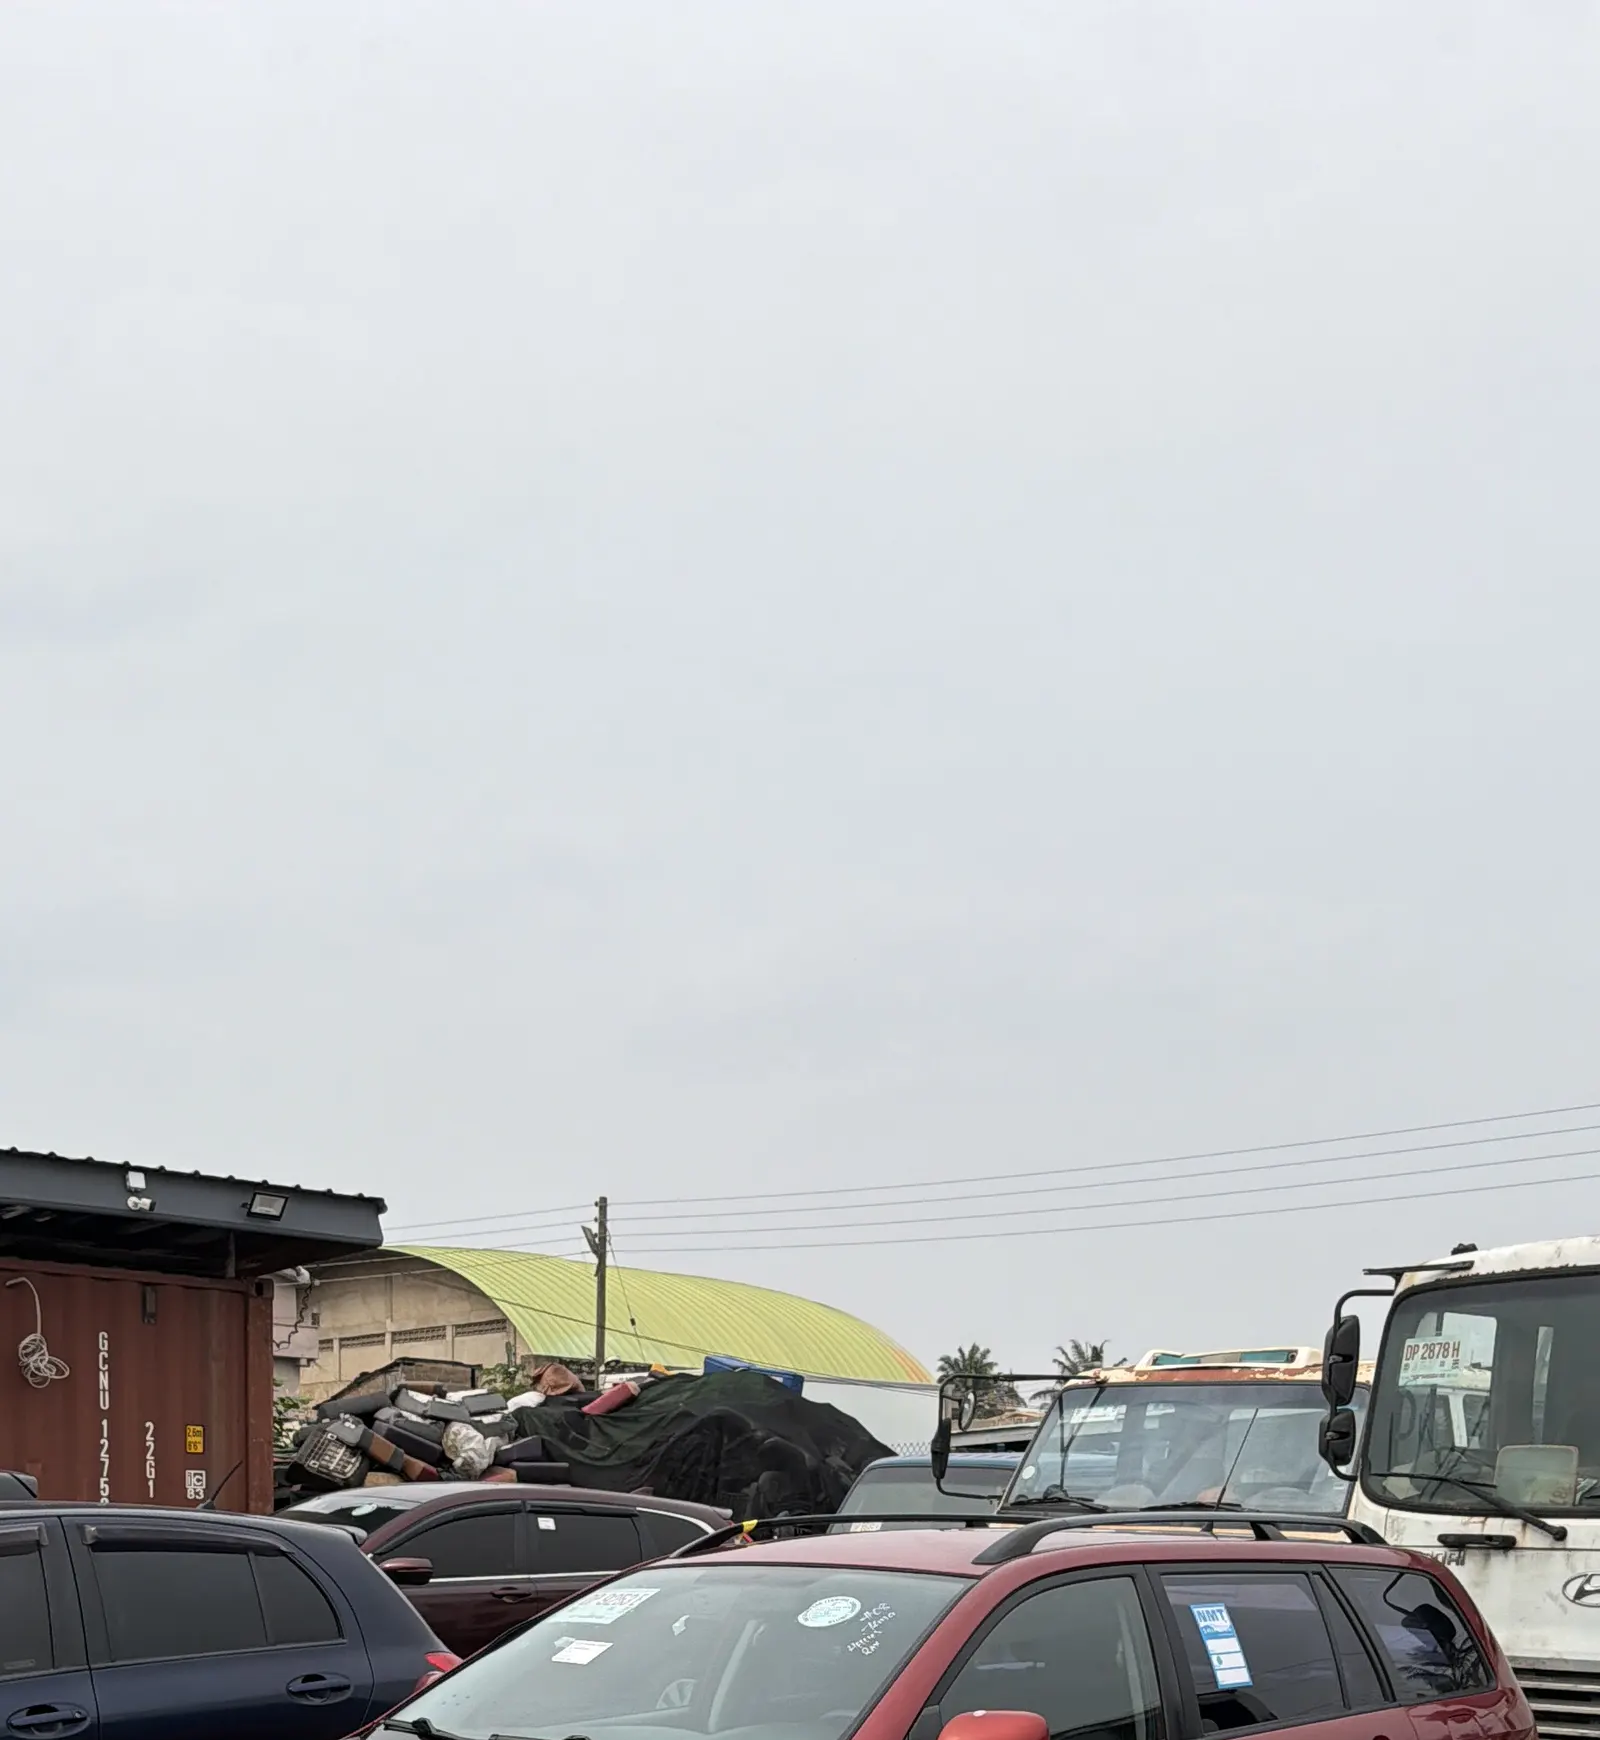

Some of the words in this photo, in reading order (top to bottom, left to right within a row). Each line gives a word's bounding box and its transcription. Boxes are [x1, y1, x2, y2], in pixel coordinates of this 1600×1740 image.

[1404, 1344, 1420, 1361] DP
[1420, 1341, 1450, 1360] 2878
[1451, 1340, 1460, 1358] H
[99, 1331, 109, 1410] GCNU
[145, 1421, 155, 1498] 22G1
[187, 1488, 204, 1499] 83
[1196, 1608, 1227, 1623] NMT
